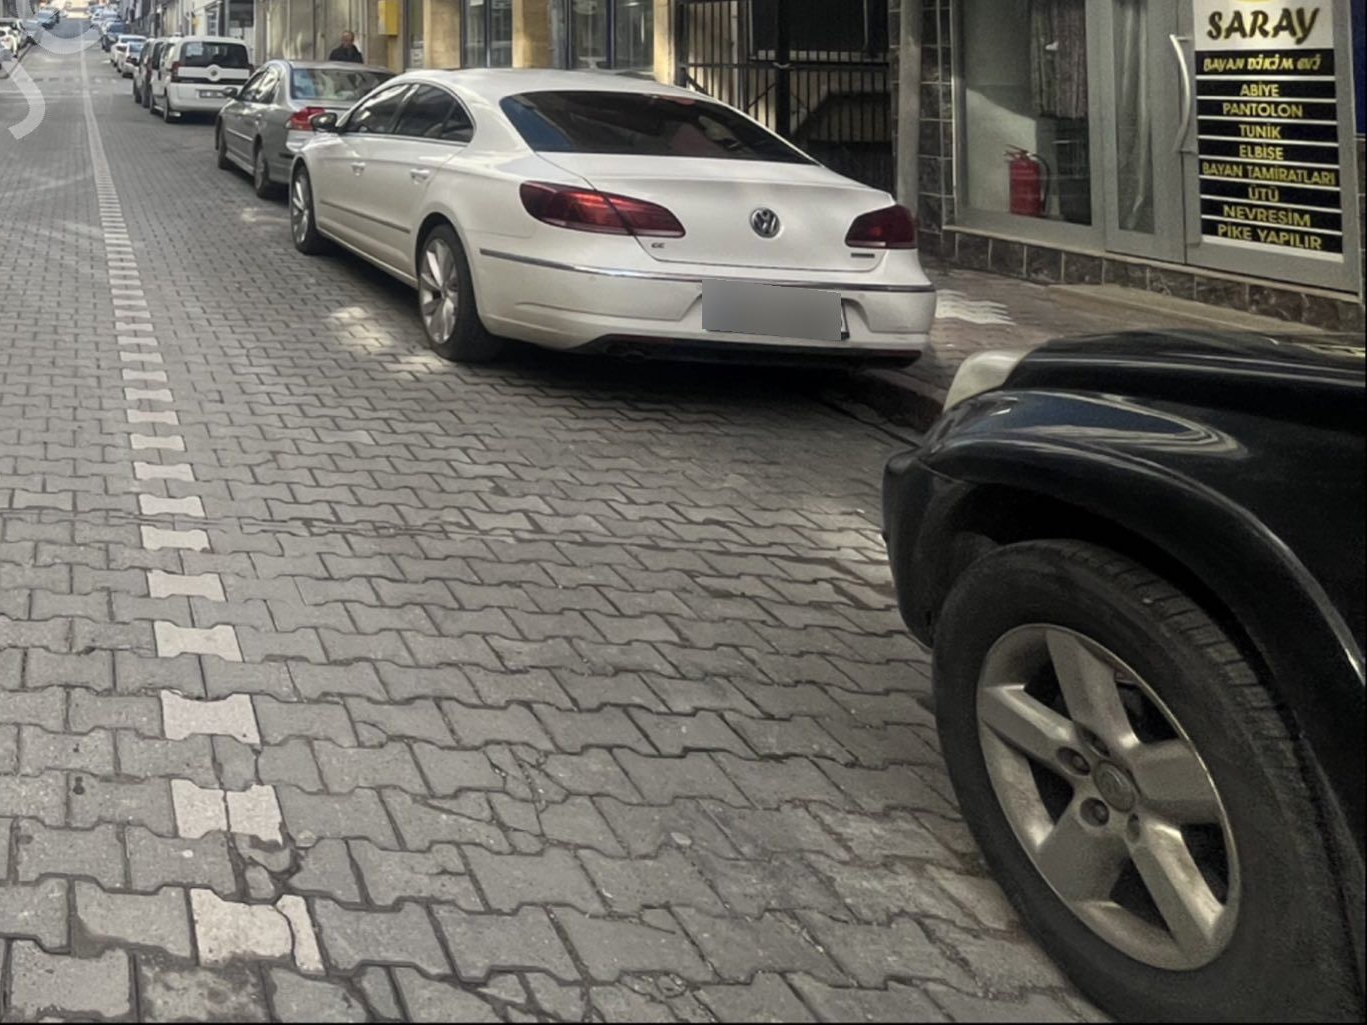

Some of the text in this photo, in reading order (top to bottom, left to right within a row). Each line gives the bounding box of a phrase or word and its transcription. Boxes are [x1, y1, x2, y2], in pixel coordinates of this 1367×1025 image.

[1206, 7, 1321, 45] SARAY
[1203, 57, 1245, 73] BAYAN
[1247, 54, 1294, 71] DİKİM
[1239, 81, 1279, 97] ABİYE
[1222, 102, 1303, 118] PANTOLON
[1238, 122, 1281, 139] TUNİK
[1238, 144, 1284, 161] ELBİŞE
[1202, 161, 1336, 185] BAYAN TAMİRATLARI
[1247, 185, 1279, 202] ÜTÜ
[1222, 204, 1311, 227] NEVRESİM
[1217, 222, 1322, 250] PİKE YAPILIR
